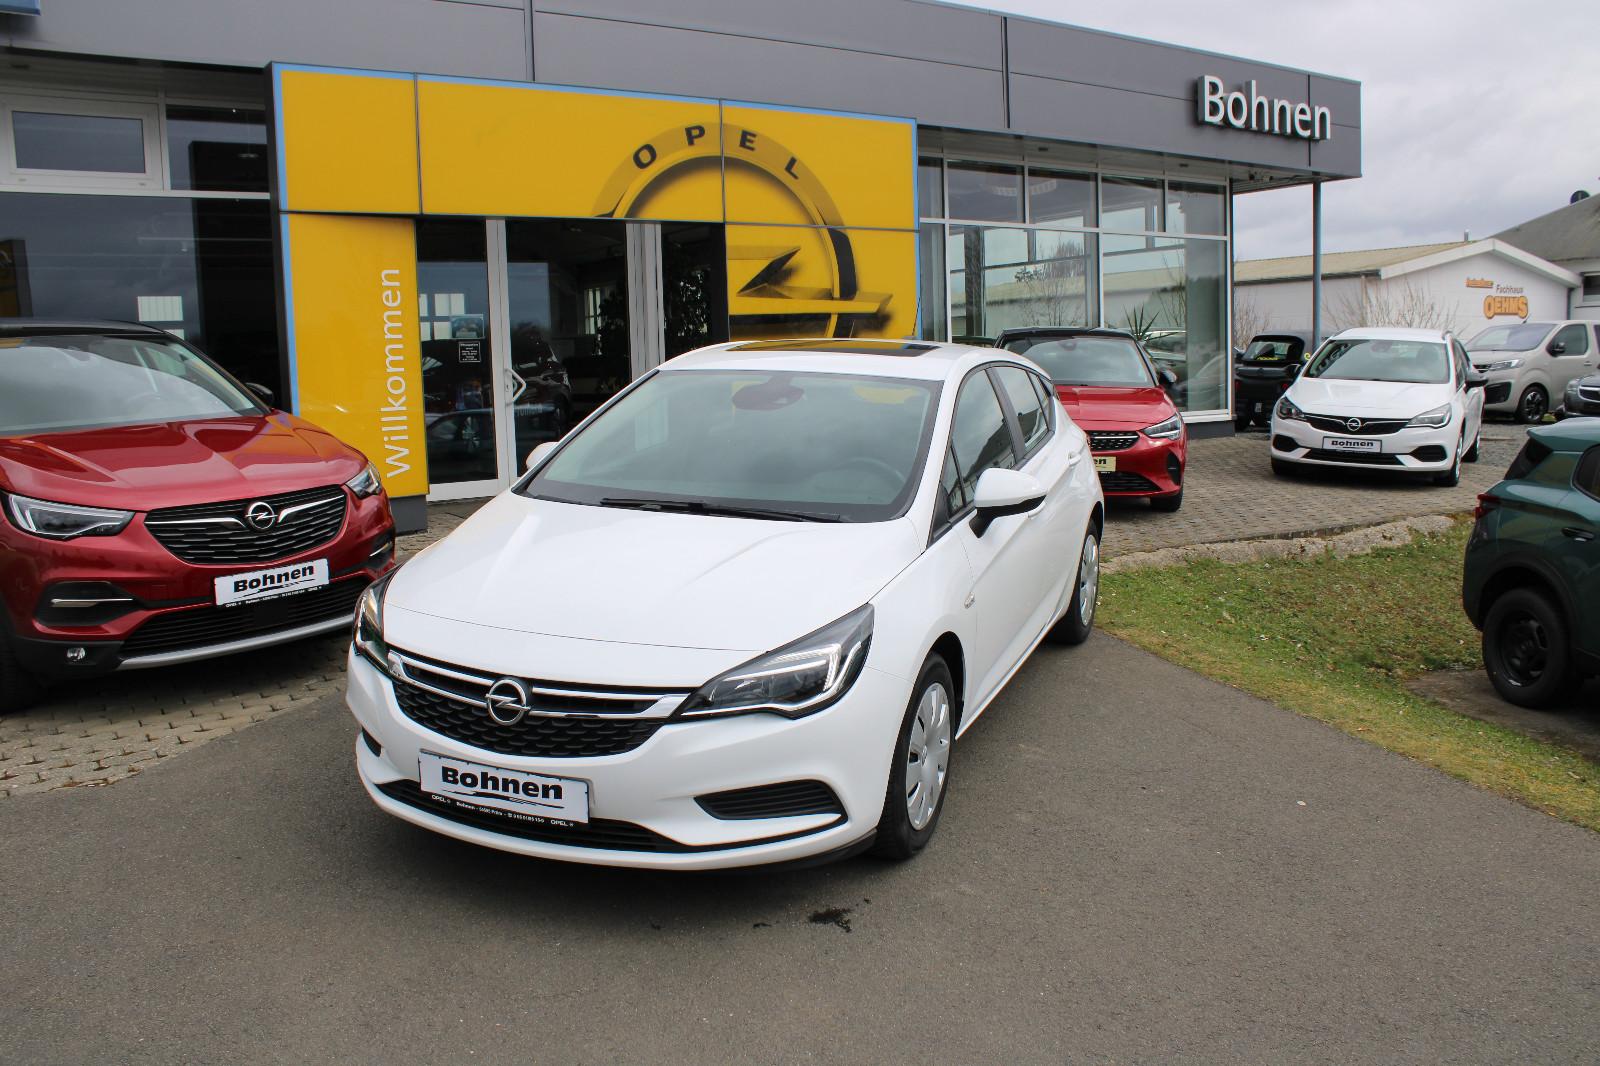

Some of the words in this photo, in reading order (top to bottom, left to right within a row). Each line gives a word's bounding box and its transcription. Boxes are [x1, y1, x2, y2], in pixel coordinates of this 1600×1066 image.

[1200, 75, 1331, 140] Bohnen
[632, 125, 800, 180] OPEL
[1484, 295, 1528, 319] OEHMS
[381, 269, 410, 478] Willkommen
[233, 565, 314, 593] Bohnen
[442, 766, 563, 800] Bohnen
[551, 819, 569, 827] OPEL
